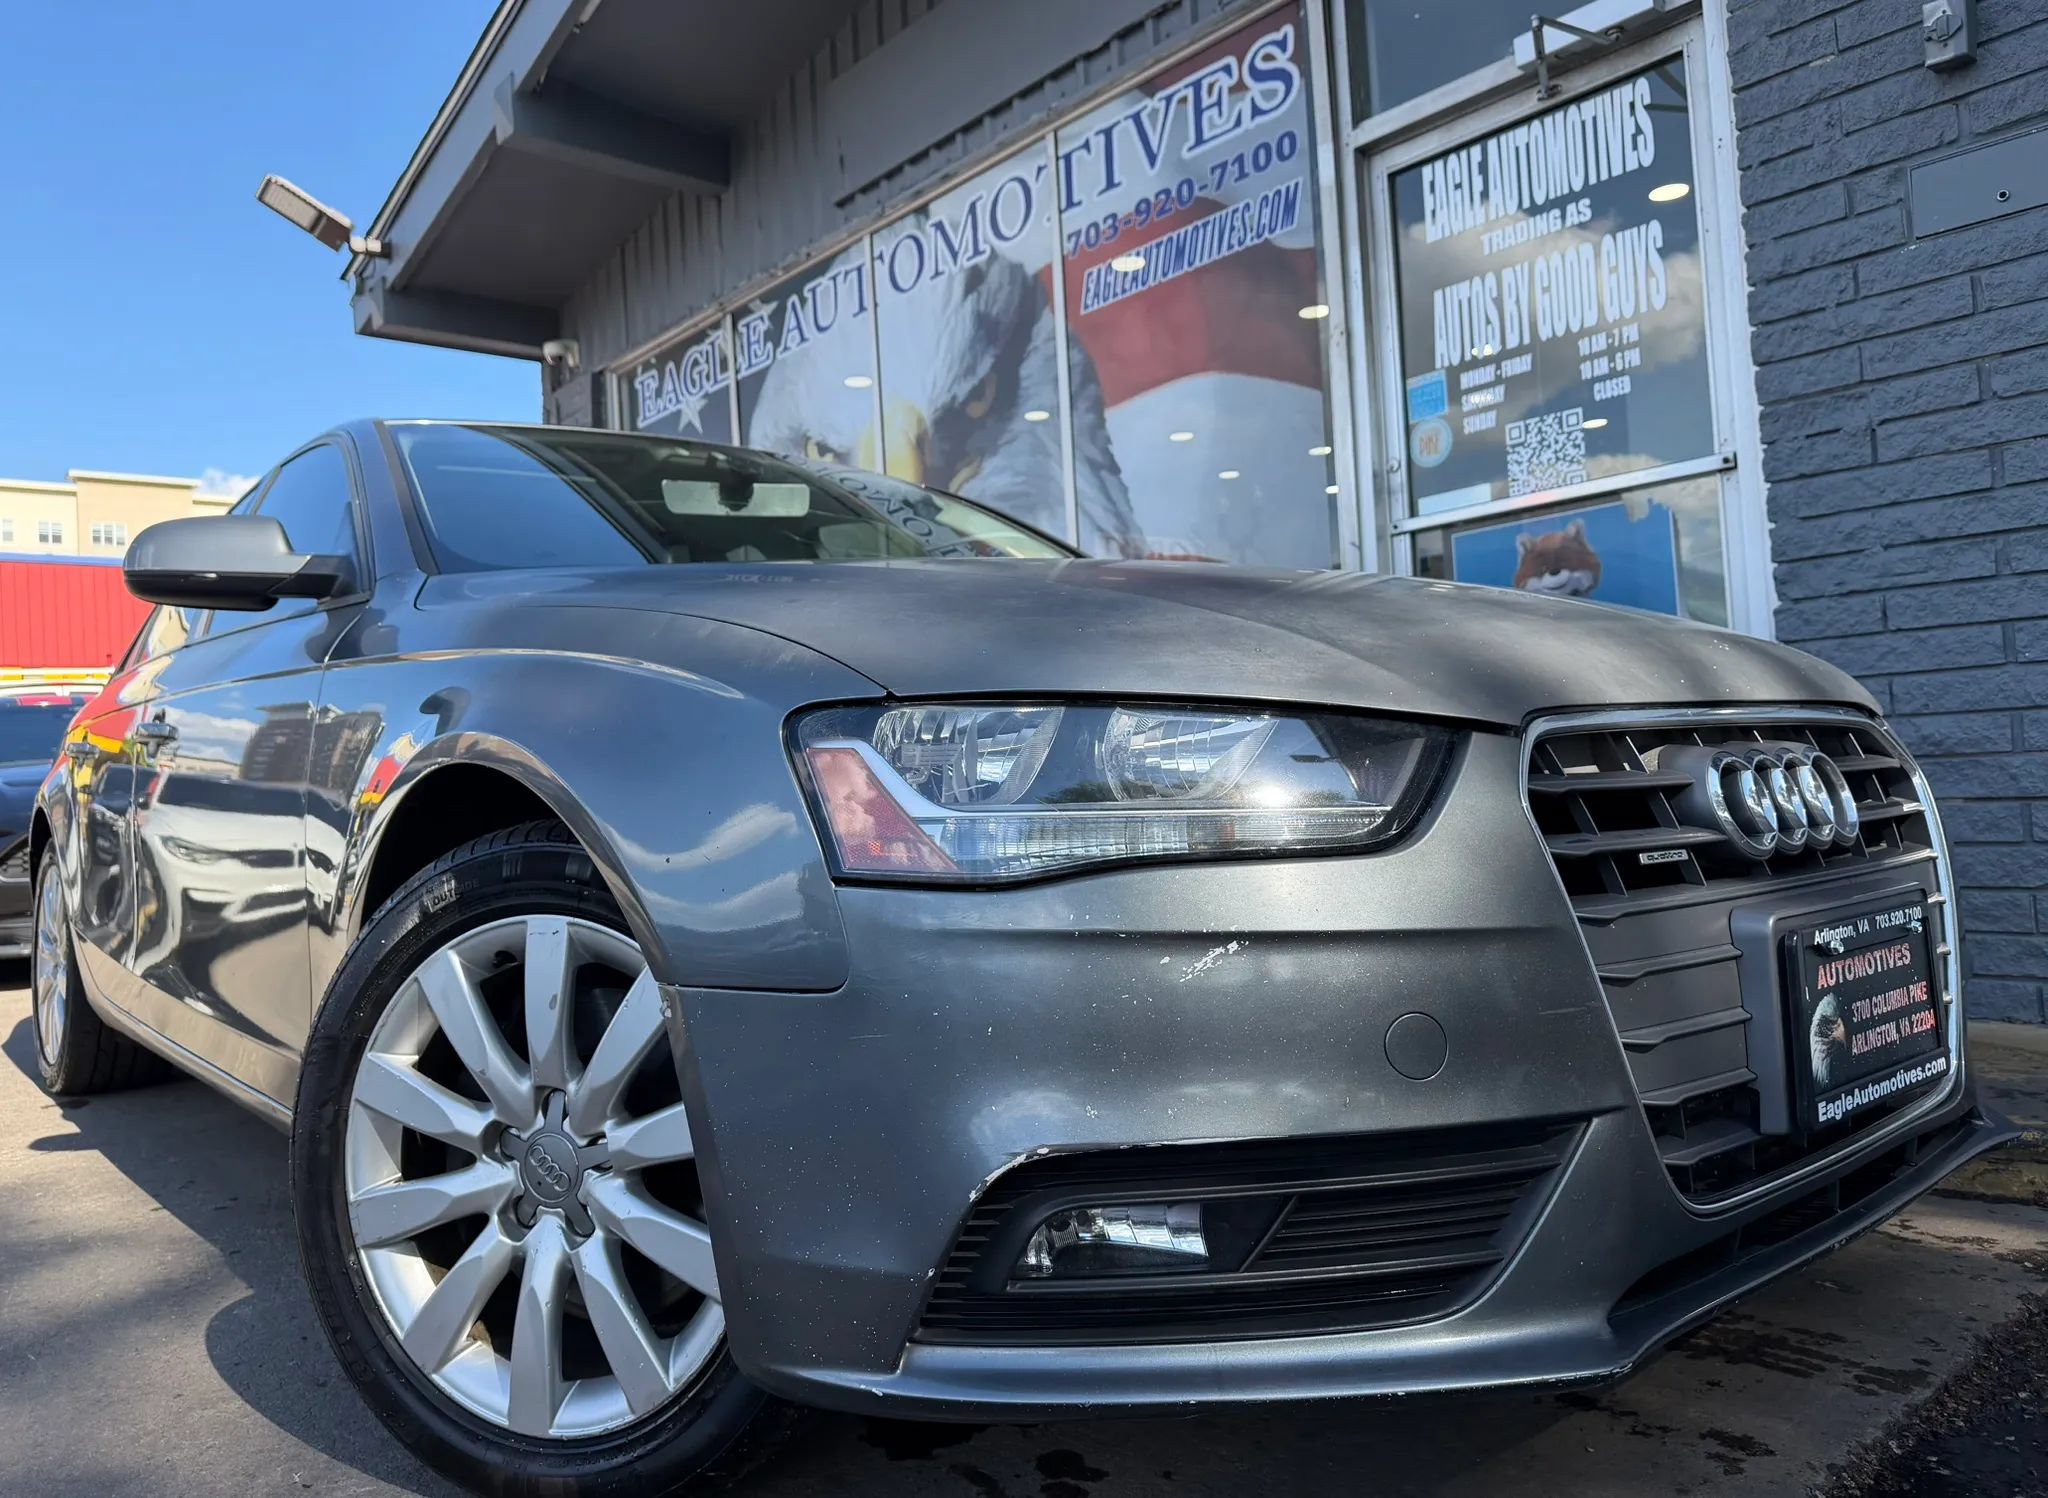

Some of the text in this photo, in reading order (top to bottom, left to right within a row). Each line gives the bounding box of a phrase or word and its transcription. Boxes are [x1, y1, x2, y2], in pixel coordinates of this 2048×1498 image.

[1421, 77, 1655, 244] EAGLE AUTOMOTIVES
[1067, 130, 1297, 257] 703-920-7100
[636, 24, 1300, 428] EAGLE AUTOMOTIVES
[1081, 178, 1302, 314] EAGLEAUTOMOTIVES.COM
[1480, 197, 1592, 256] TRADING AS
[1433, 219, 1666, 369] AUTOS BY GOOD GUYS
[1591, 331, 1608, 354] AM
[1612, 328, 1619, 347] 7
[1622, 322, 1639, 345] PM
[1460, 363, 1496, 391] MONDAY
[1501, 352, 1533, 379] FRIDAY
[1593, 356, 1610, 378] AM
[1624, 347, 1641, 369] PM
[1594, 375, 1631, 402] CLOSED
[1463, 410, 1498, 435] SUNDAY
[1646, 851, 1683, 862] quattro
[1814, 906, 1922, 945] Arlington, VA 703.920.7100
[1817, 942, 1911, 989] AUTOMOTIVES
[1852, 981, 1928, 1023] 3700 COLUMBIA PIKE
[1852, 1008, 1936, 1056] ARLINGTON, VA 22204
[1818, 1057, 1947, 1122] EagleAutomotives.com
